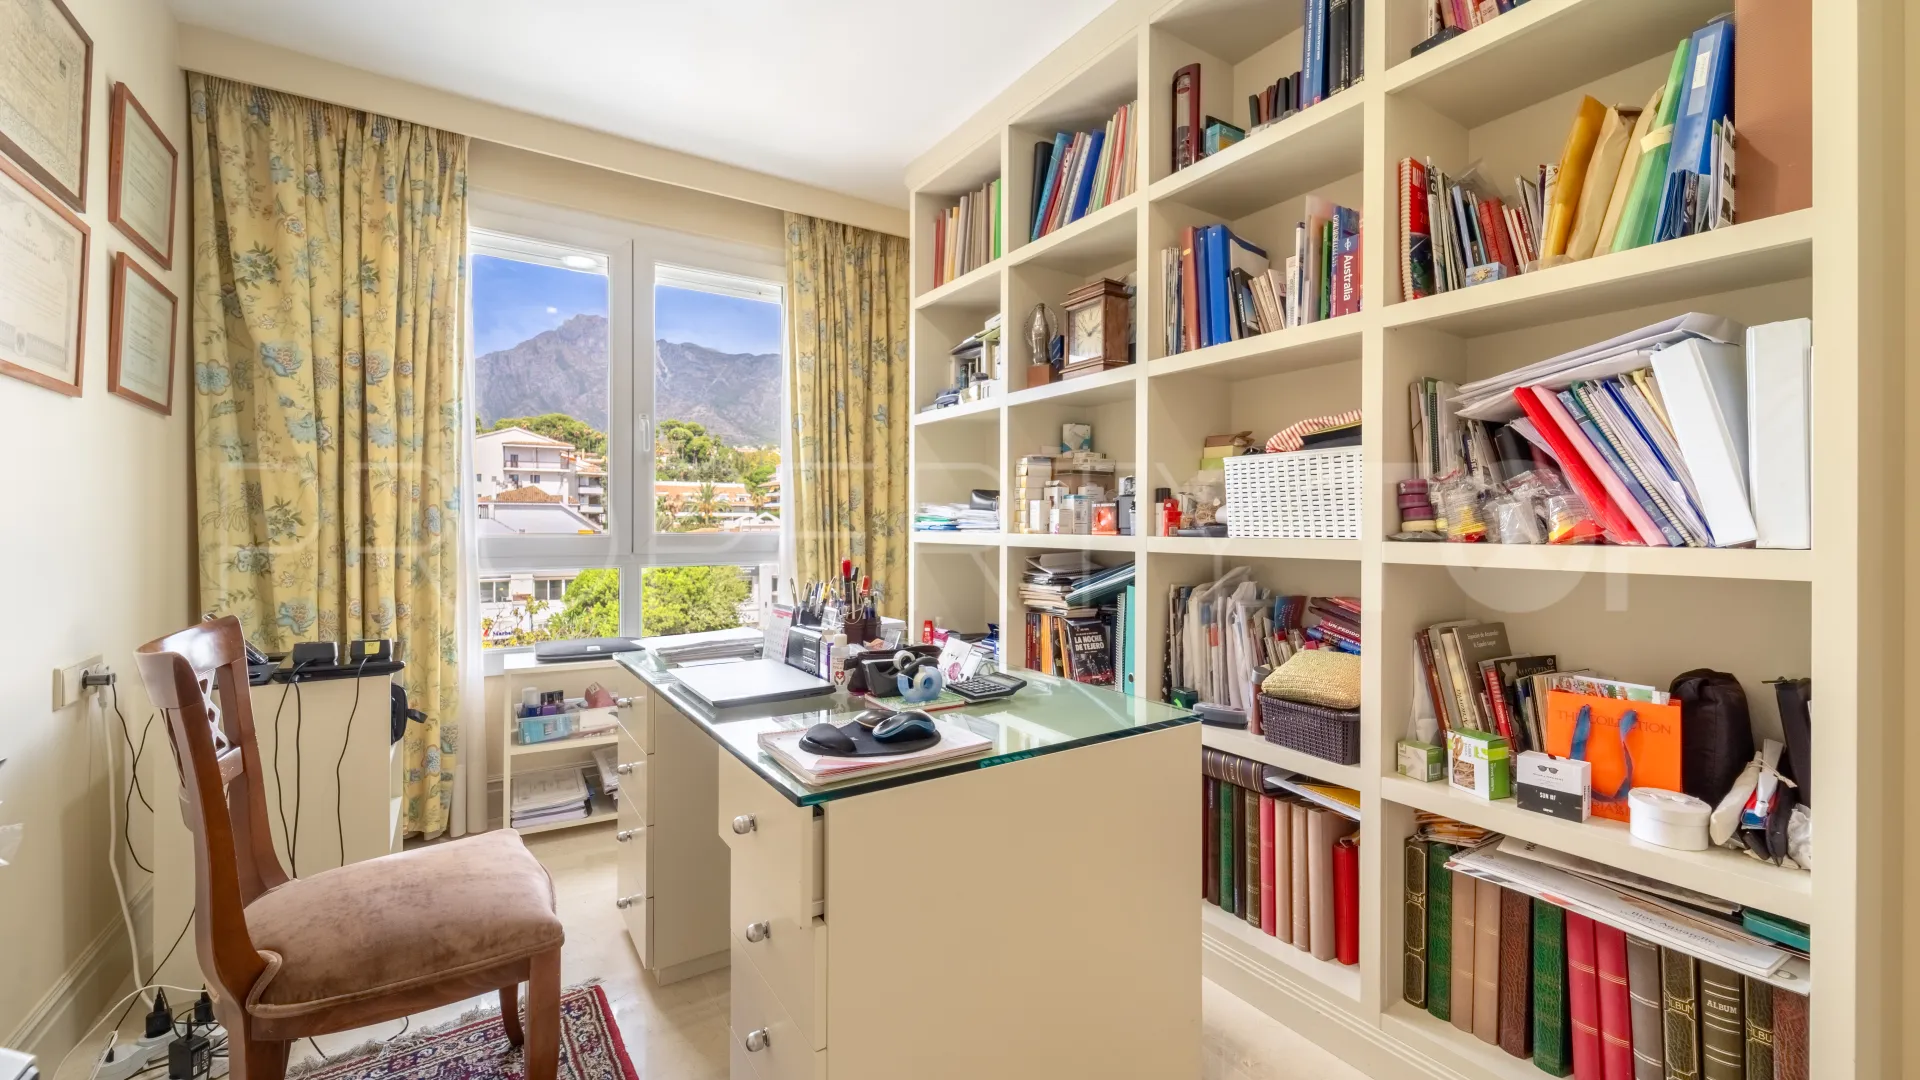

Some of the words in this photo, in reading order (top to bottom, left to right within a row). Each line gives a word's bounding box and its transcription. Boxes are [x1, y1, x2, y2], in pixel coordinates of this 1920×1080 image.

[1342, 255, 1354, 301] Australia
[1074, 636, 1082, 644] LA
[1082, 634, 1102, 644] NOCHE
[1075, 644, 1084, 652] DE
[1084, 642, 1105, 651] TEJERO
[1540, 792, 1549, 800] SUN
[1706, 999, 1738, 1014] ALBUM
